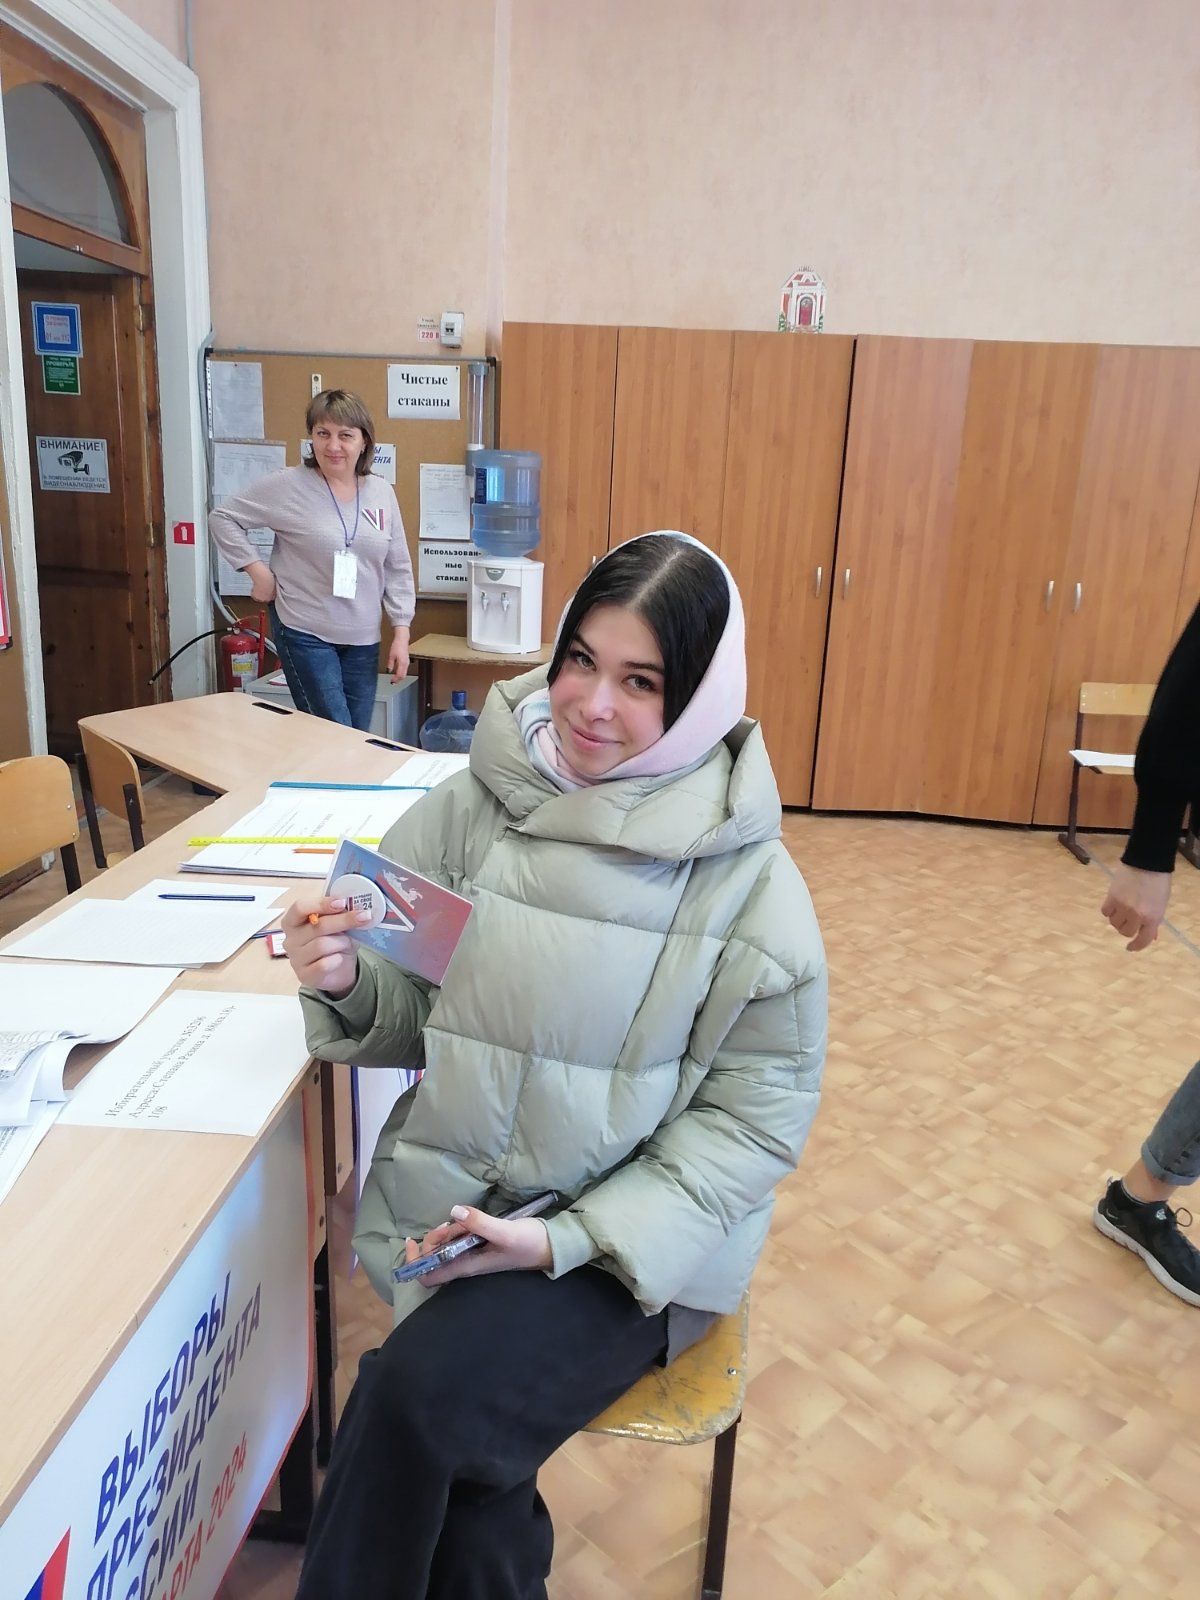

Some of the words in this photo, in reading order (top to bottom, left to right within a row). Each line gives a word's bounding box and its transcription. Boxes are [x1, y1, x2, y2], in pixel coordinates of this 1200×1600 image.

[421, 331, 434, 339] 220
[401, 373, 448, 385] Чистые
[398, 397, 450, 407] стаканы
[40, 440, 104, 451] ВНИМАНИЕ!
[373, 456, 391, 464] ЕНТА
[424, 548, 481, 556] Использован-
[363, 902, 372, 910] 24
[105, 1060, 164, 1116] Избирательный
[147, 1106, 168, 1118] 108
[94, 1271, 231, 1548] ВЫБОРЫ
[87, 1282, 261, 1600] ПРЕЗИДЕНТА
[162, 1520, 203, 1600] РТА
[206, 1431, 247, 1544] 2024
